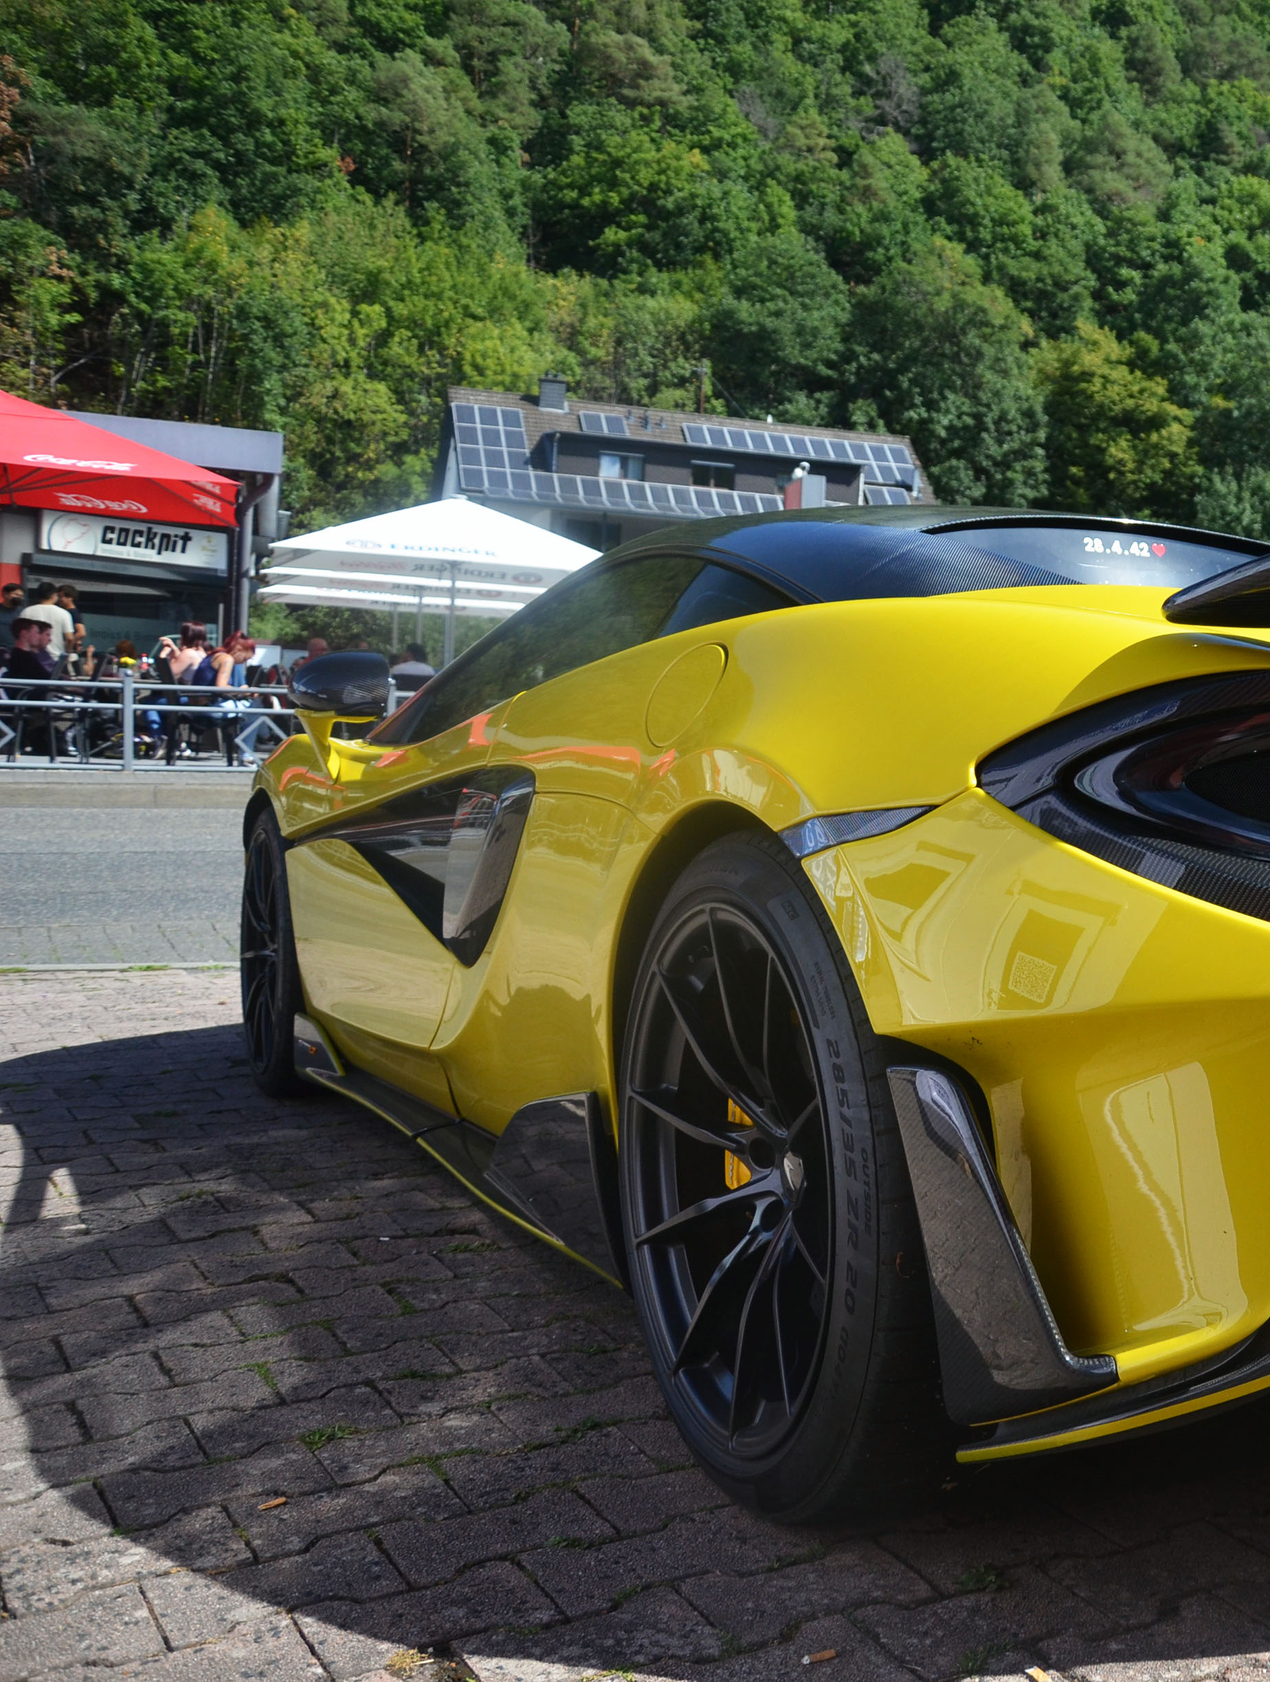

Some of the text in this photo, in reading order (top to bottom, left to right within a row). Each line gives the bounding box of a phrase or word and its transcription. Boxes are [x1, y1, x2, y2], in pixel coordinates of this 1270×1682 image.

[101, 525, 192, 555] cockpit
[389, 543, 498, 557] ERDINGER
[1083, 537, 1151, 557] 28.4.42
[826, 1039, 857, 1181] 285/35
[846, 1189, 860, 1250] ZR
[861, 1148, 872, 1237] OUTSIDE
[844, 1260, 858, 1316] 20
